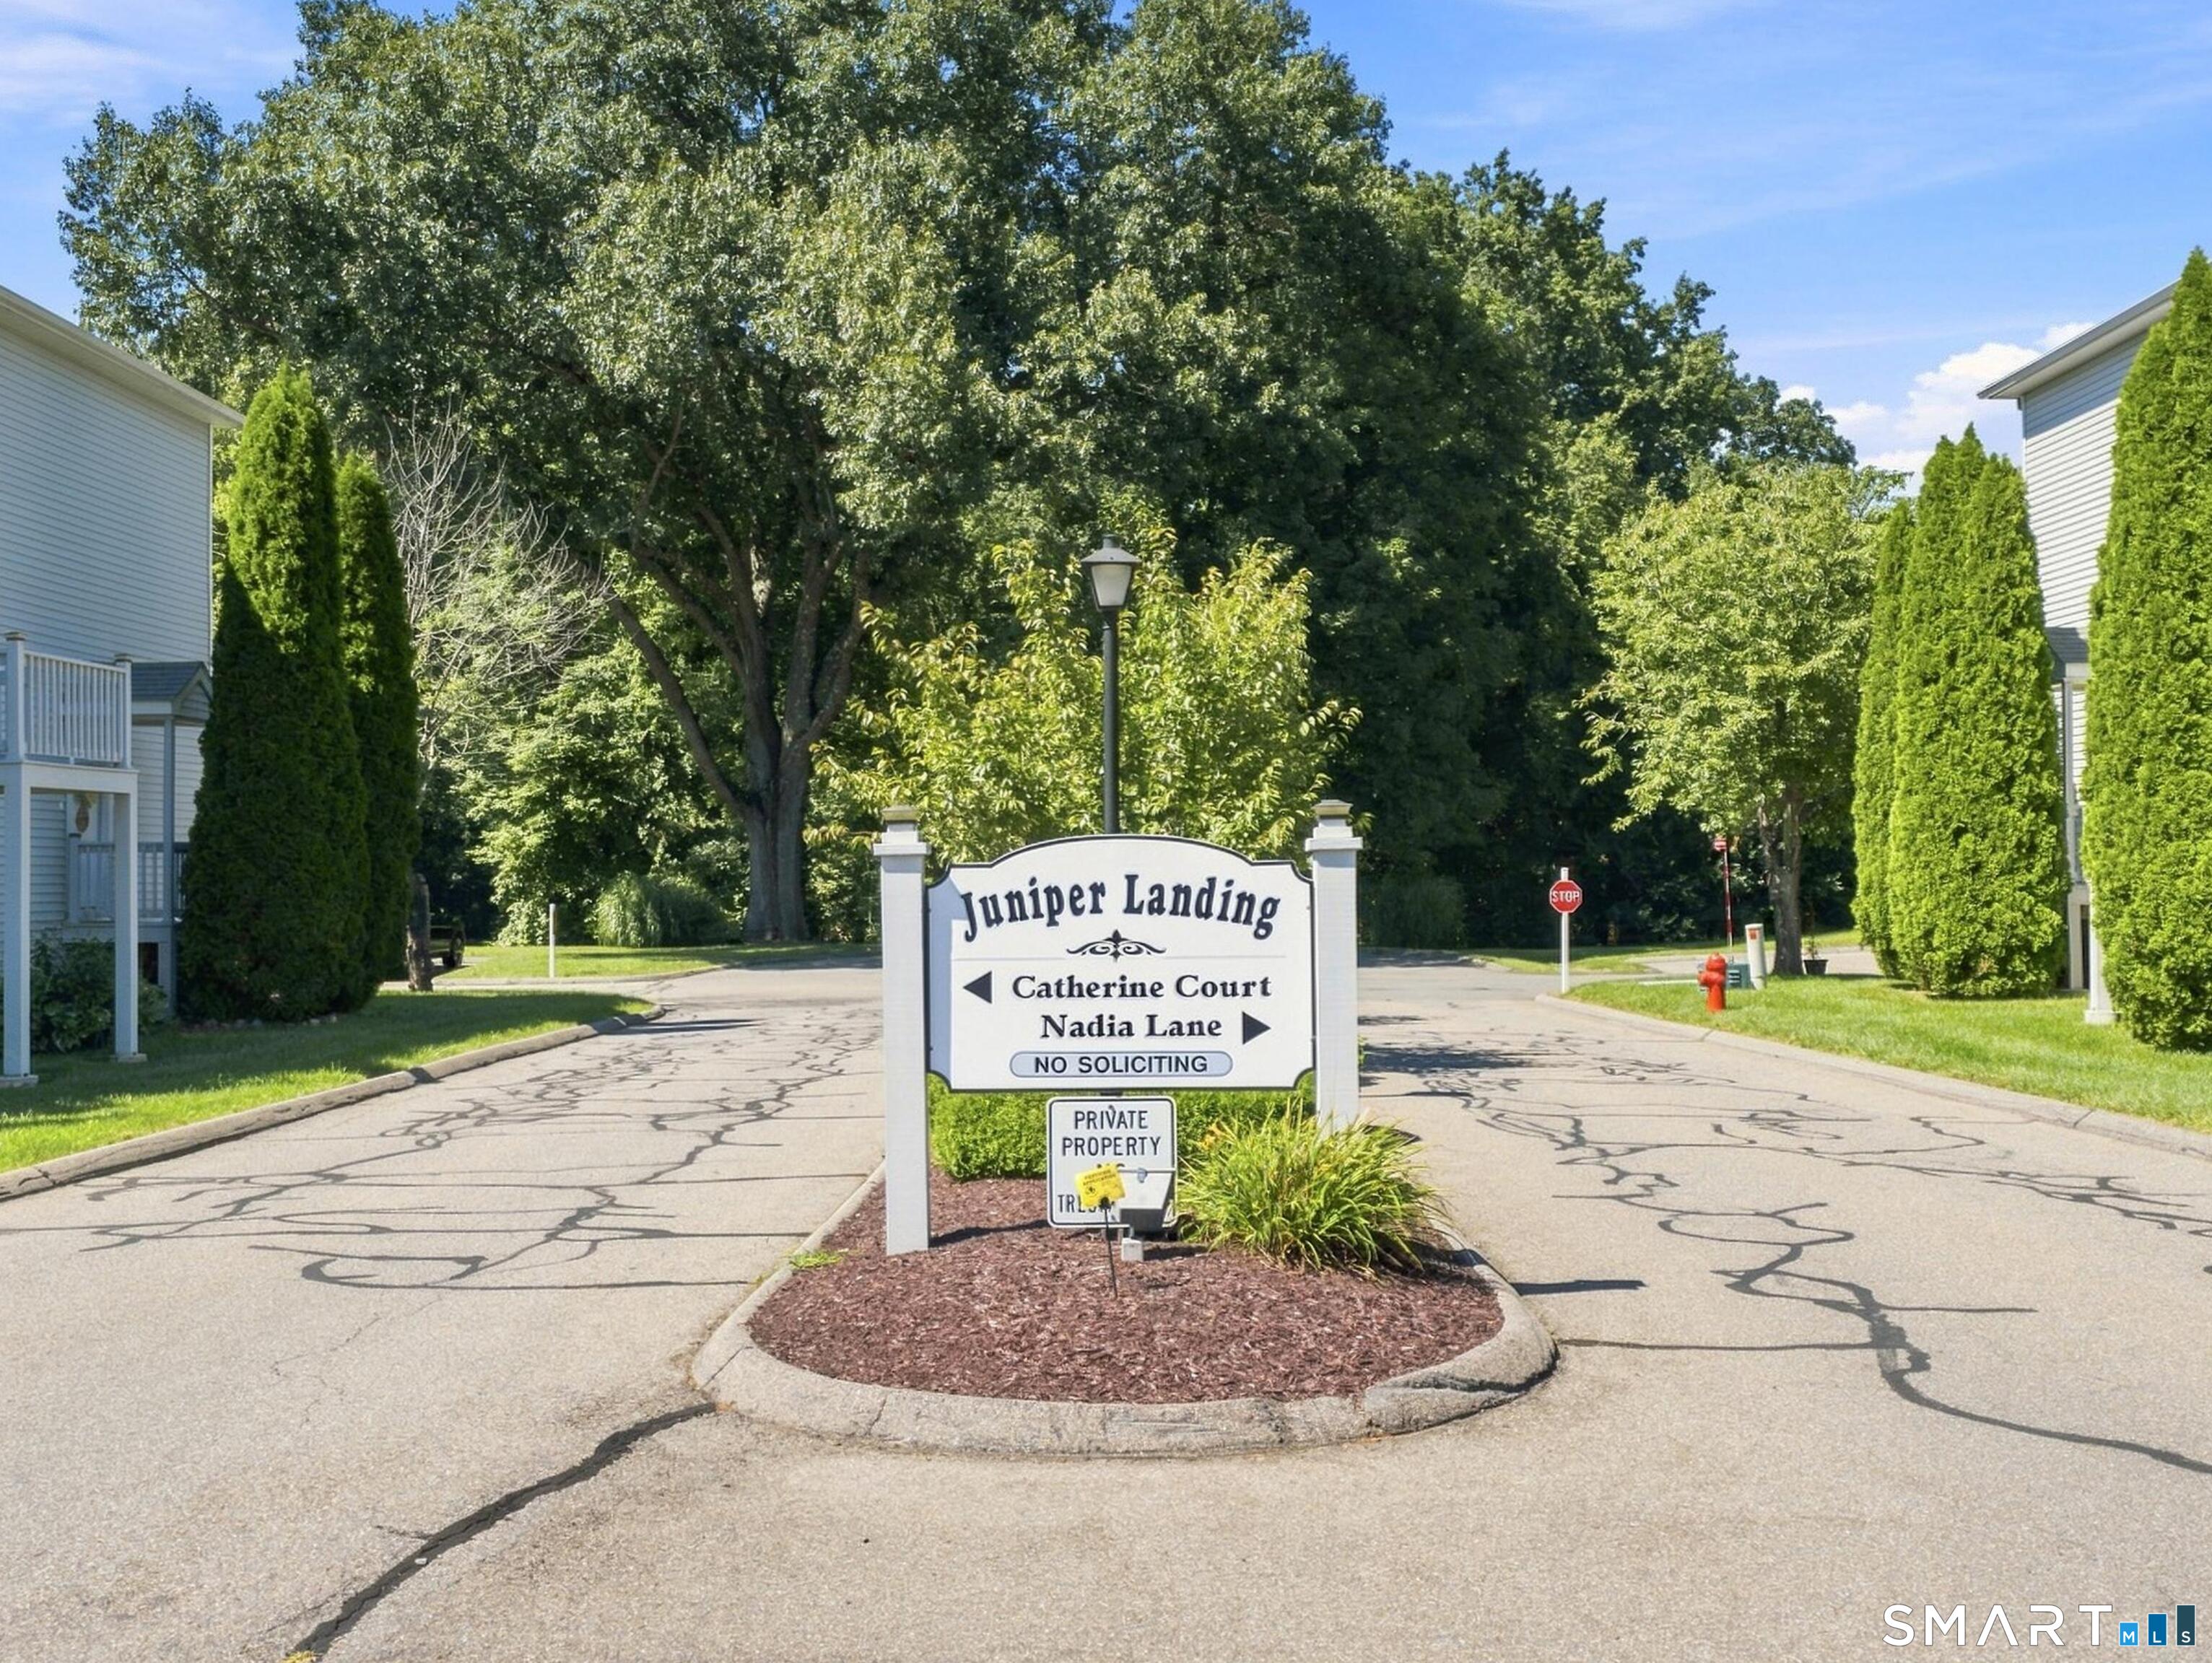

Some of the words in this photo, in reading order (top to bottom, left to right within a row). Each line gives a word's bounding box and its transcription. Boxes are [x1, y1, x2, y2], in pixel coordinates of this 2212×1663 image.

[1552, 890, 1580, 903] STOP
[961, 876, 1106, 943] Juniper
[1123, 874, 1281, 940] Landing
[1011, 974, 1164, 998] Catherine
[1175, 974, 1272, 998] Court
[1041, 1013, 1134, 1038] Nadia
[1146, 1014, 1222, 1036] Lane
[1035, 1056, 1068, 1073] NO
[1078, 1055, 1208, 1073] SOLICITING
[1074, 1110, 1149, 1130] PRIVATE
[1062, 1136, 1161, 1156] PROPERTY
